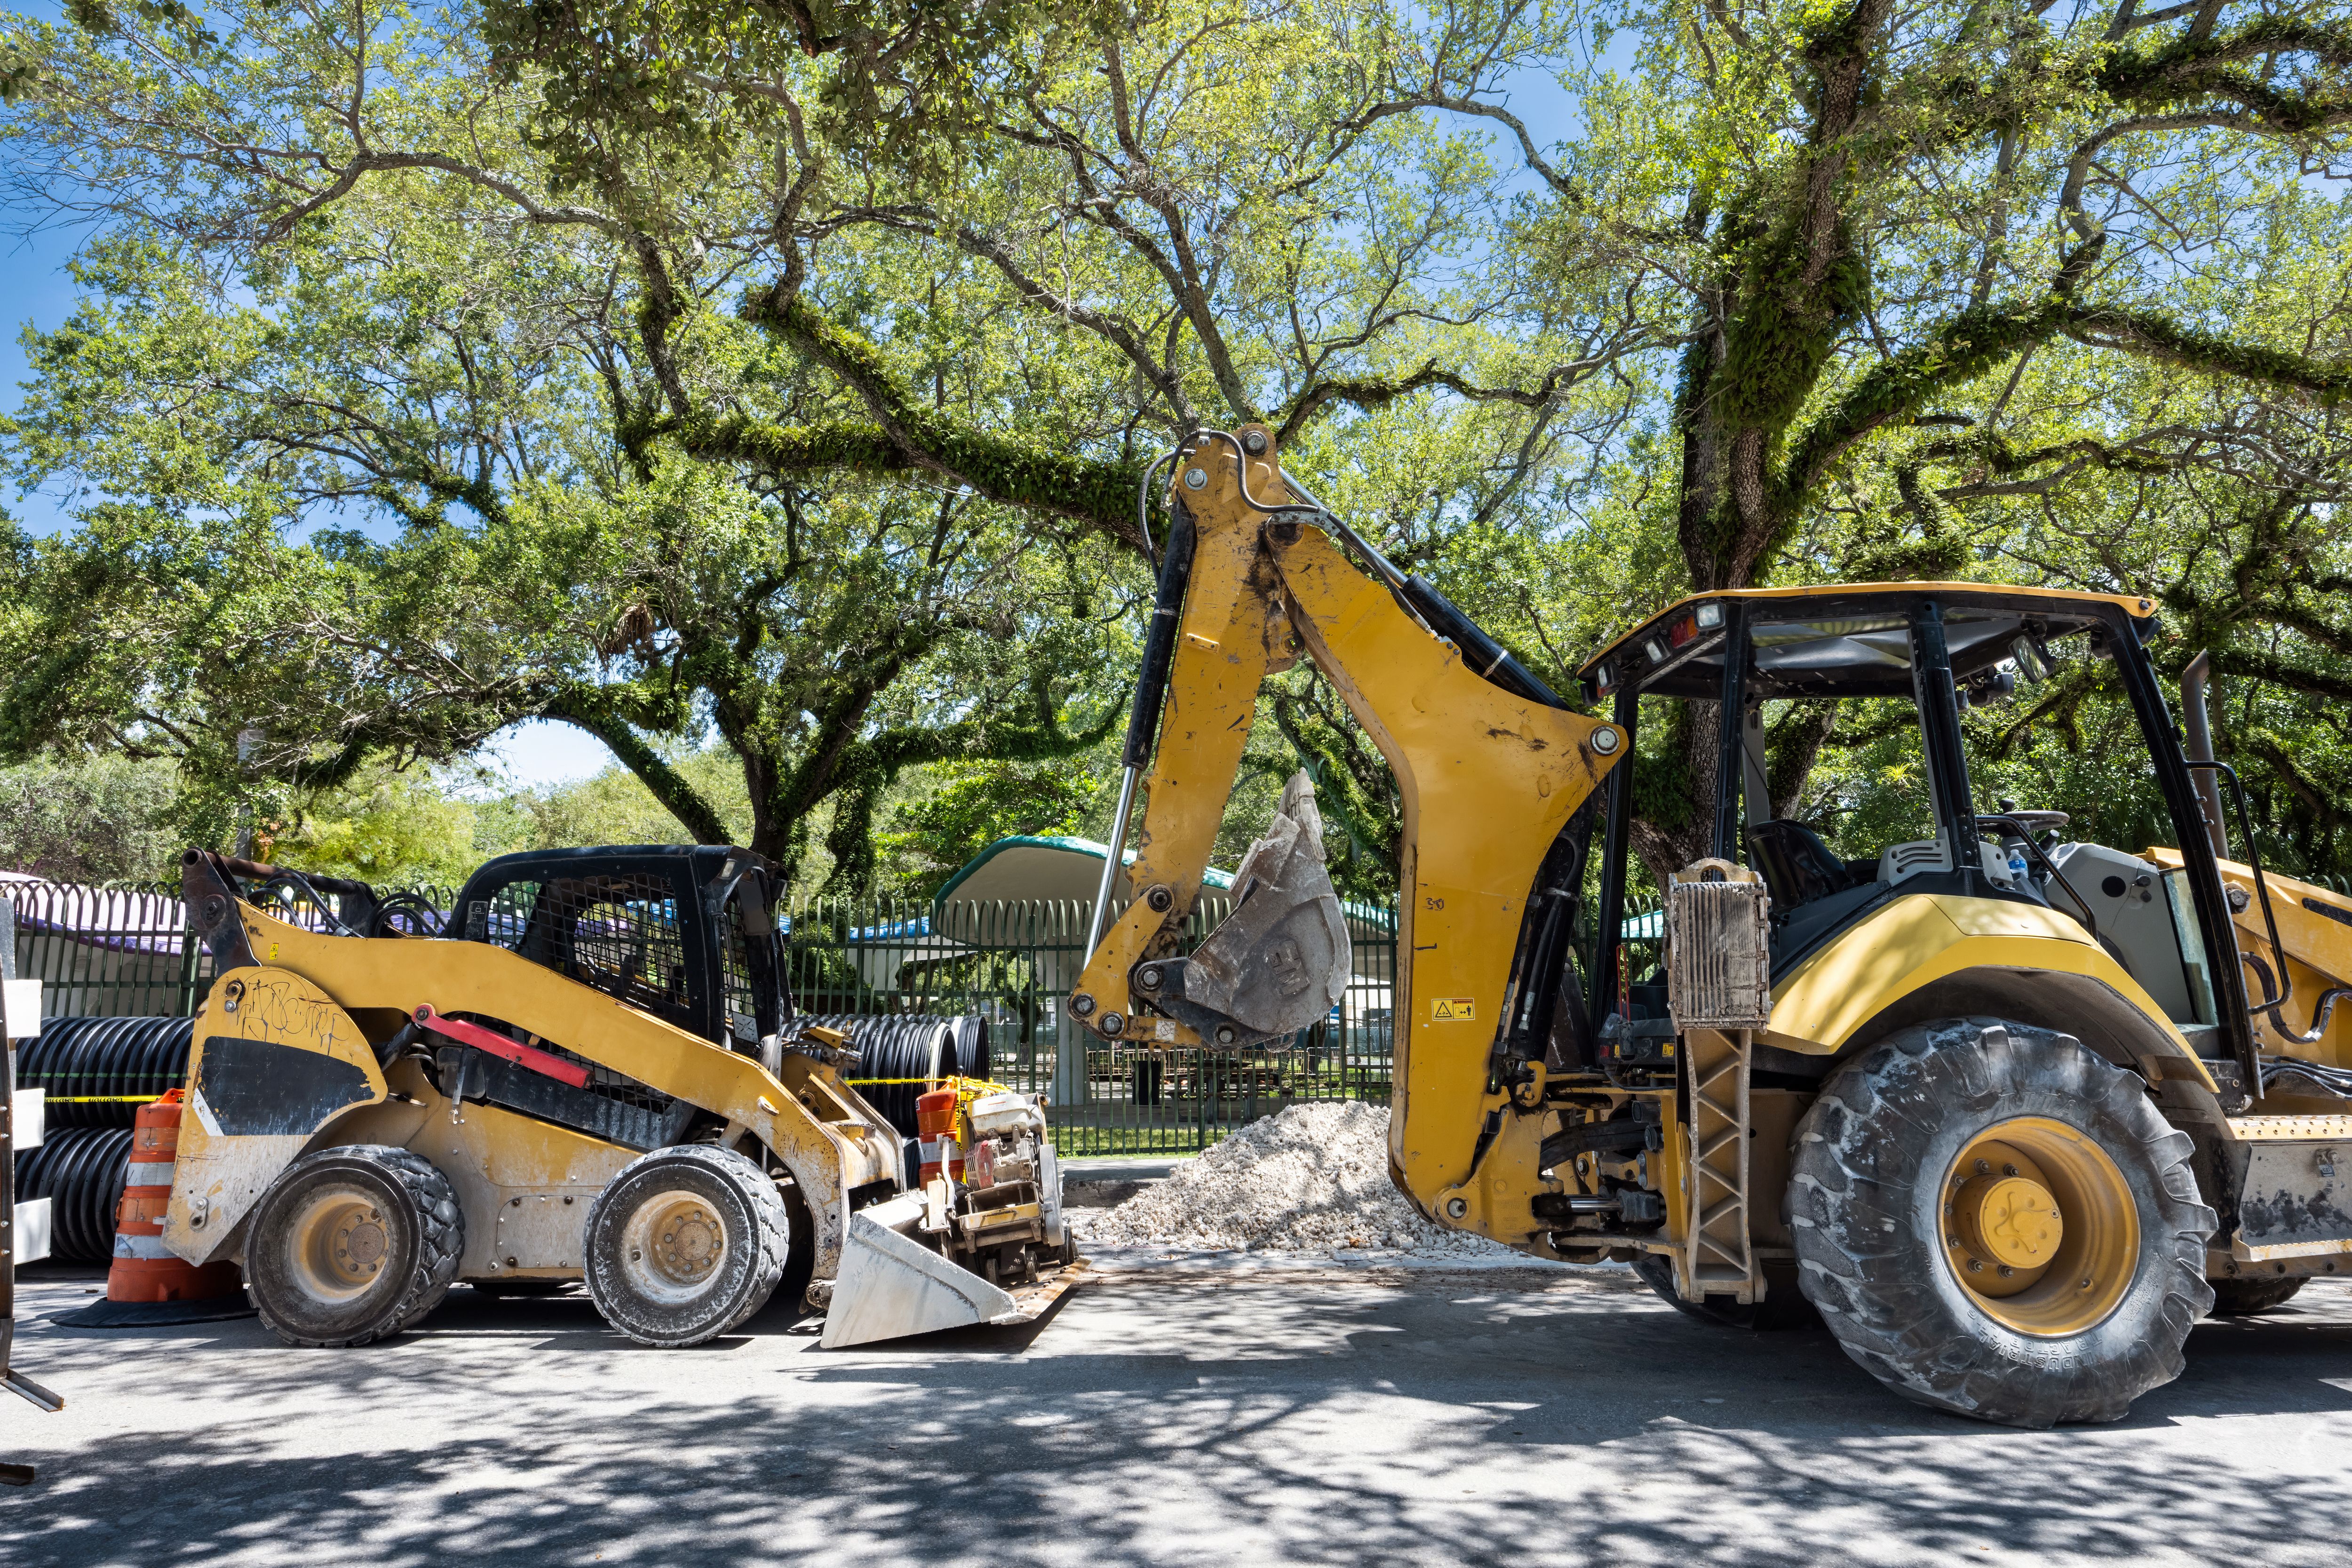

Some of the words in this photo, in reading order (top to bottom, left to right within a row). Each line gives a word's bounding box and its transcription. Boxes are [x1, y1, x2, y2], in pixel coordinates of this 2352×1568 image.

[1967, 1308, 2001, 1338] LUG
[1978, 1331, 2097, 1370] INDUSTRIAL
[2009, 1332, 2103, 1355] TRACTOR
